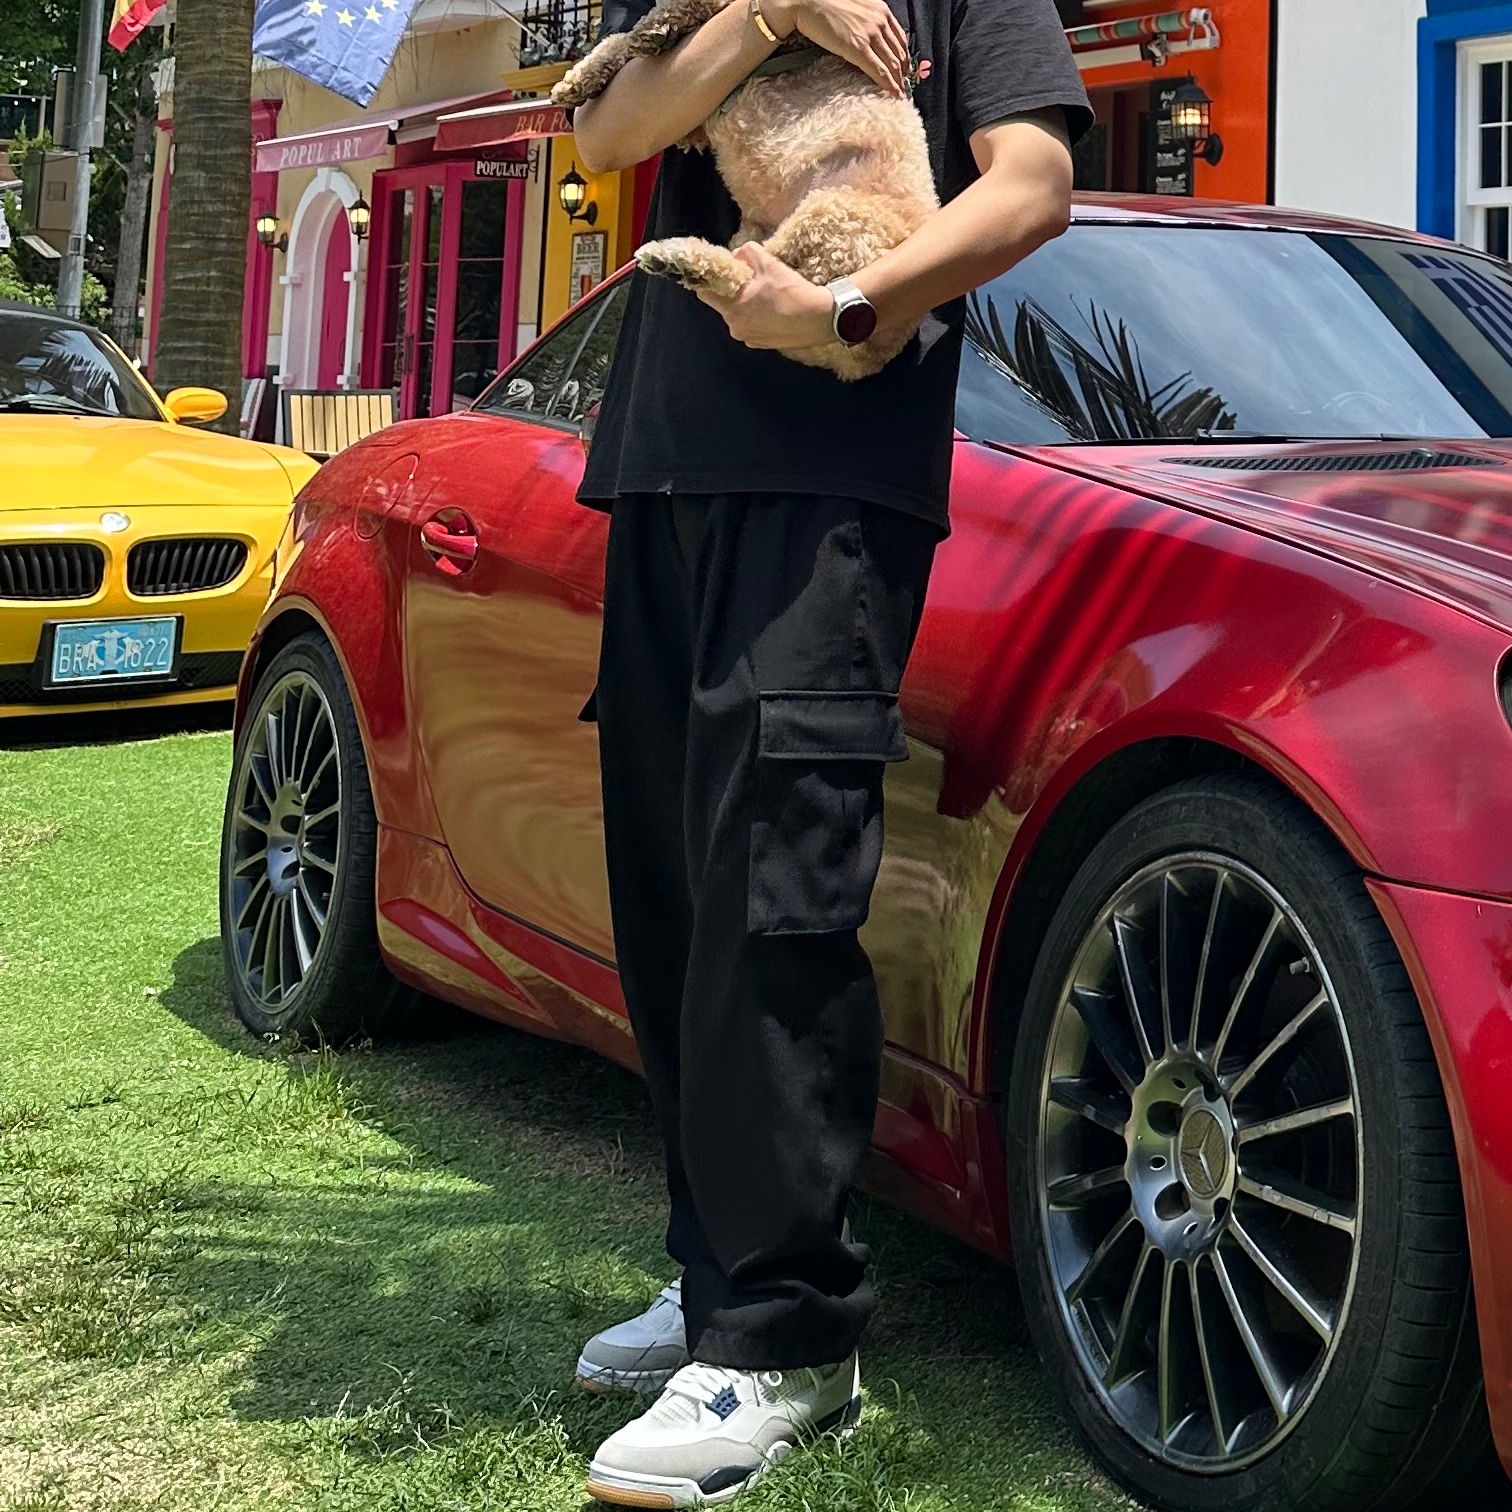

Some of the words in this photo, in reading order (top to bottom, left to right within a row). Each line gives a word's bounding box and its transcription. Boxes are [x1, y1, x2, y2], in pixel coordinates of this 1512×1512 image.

[516, 113, 545, 133] BAR
[280, 142, 325, 166] POPUL
[331, 138, 362, 159] ART
[476, 160, 529, 177] POPULART
[58, 640, 97, 673] BRA
[124, 637, 169, 669] 1822
